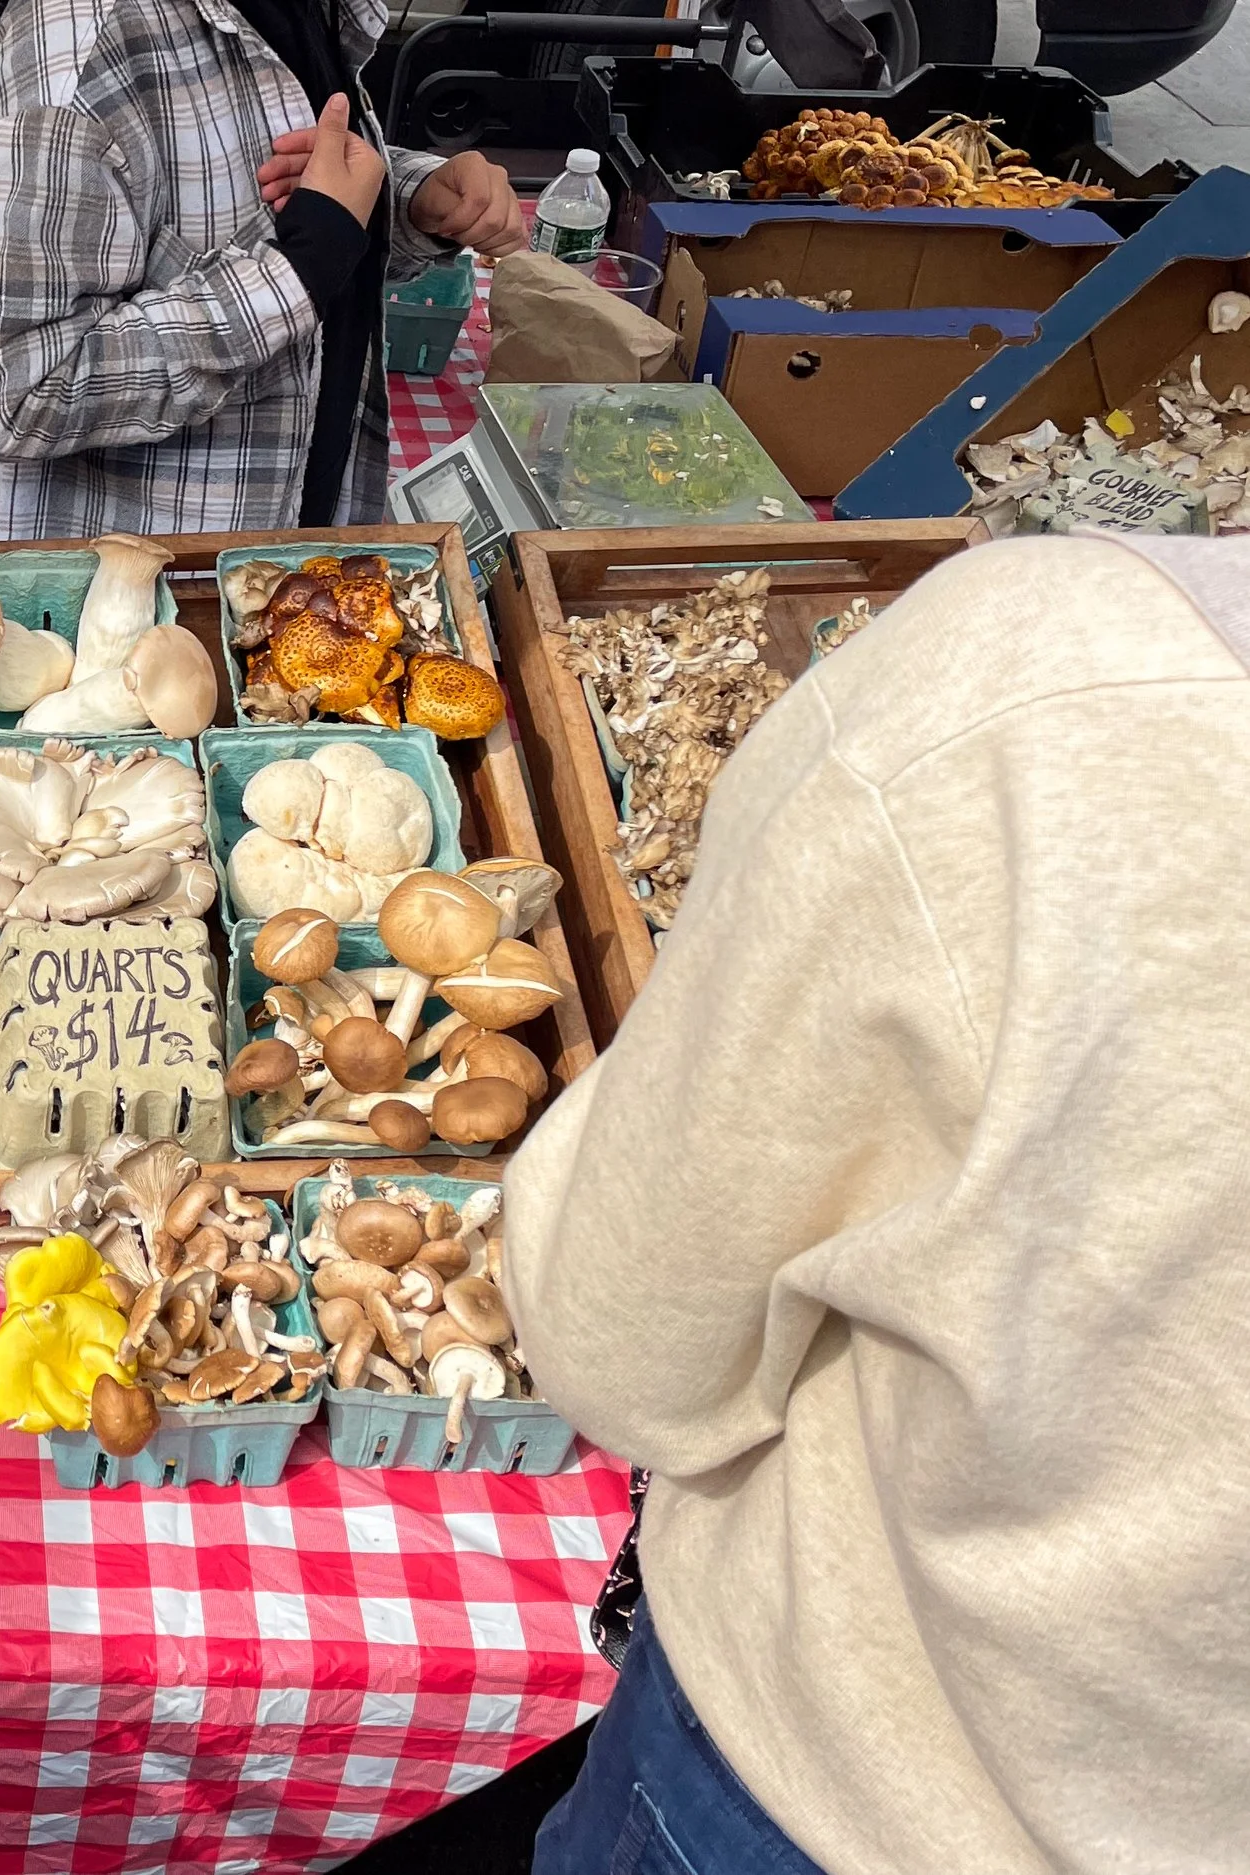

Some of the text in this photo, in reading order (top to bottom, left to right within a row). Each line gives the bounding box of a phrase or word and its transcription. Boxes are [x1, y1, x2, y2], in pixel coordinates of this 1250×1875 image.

[1084, 492, 1154, 521] BLEND
[1088, 468, 1186, 508] GOURMET
[28, 946, 191, 1008] QUARTS
[63, 995, 166, 1081] $14
